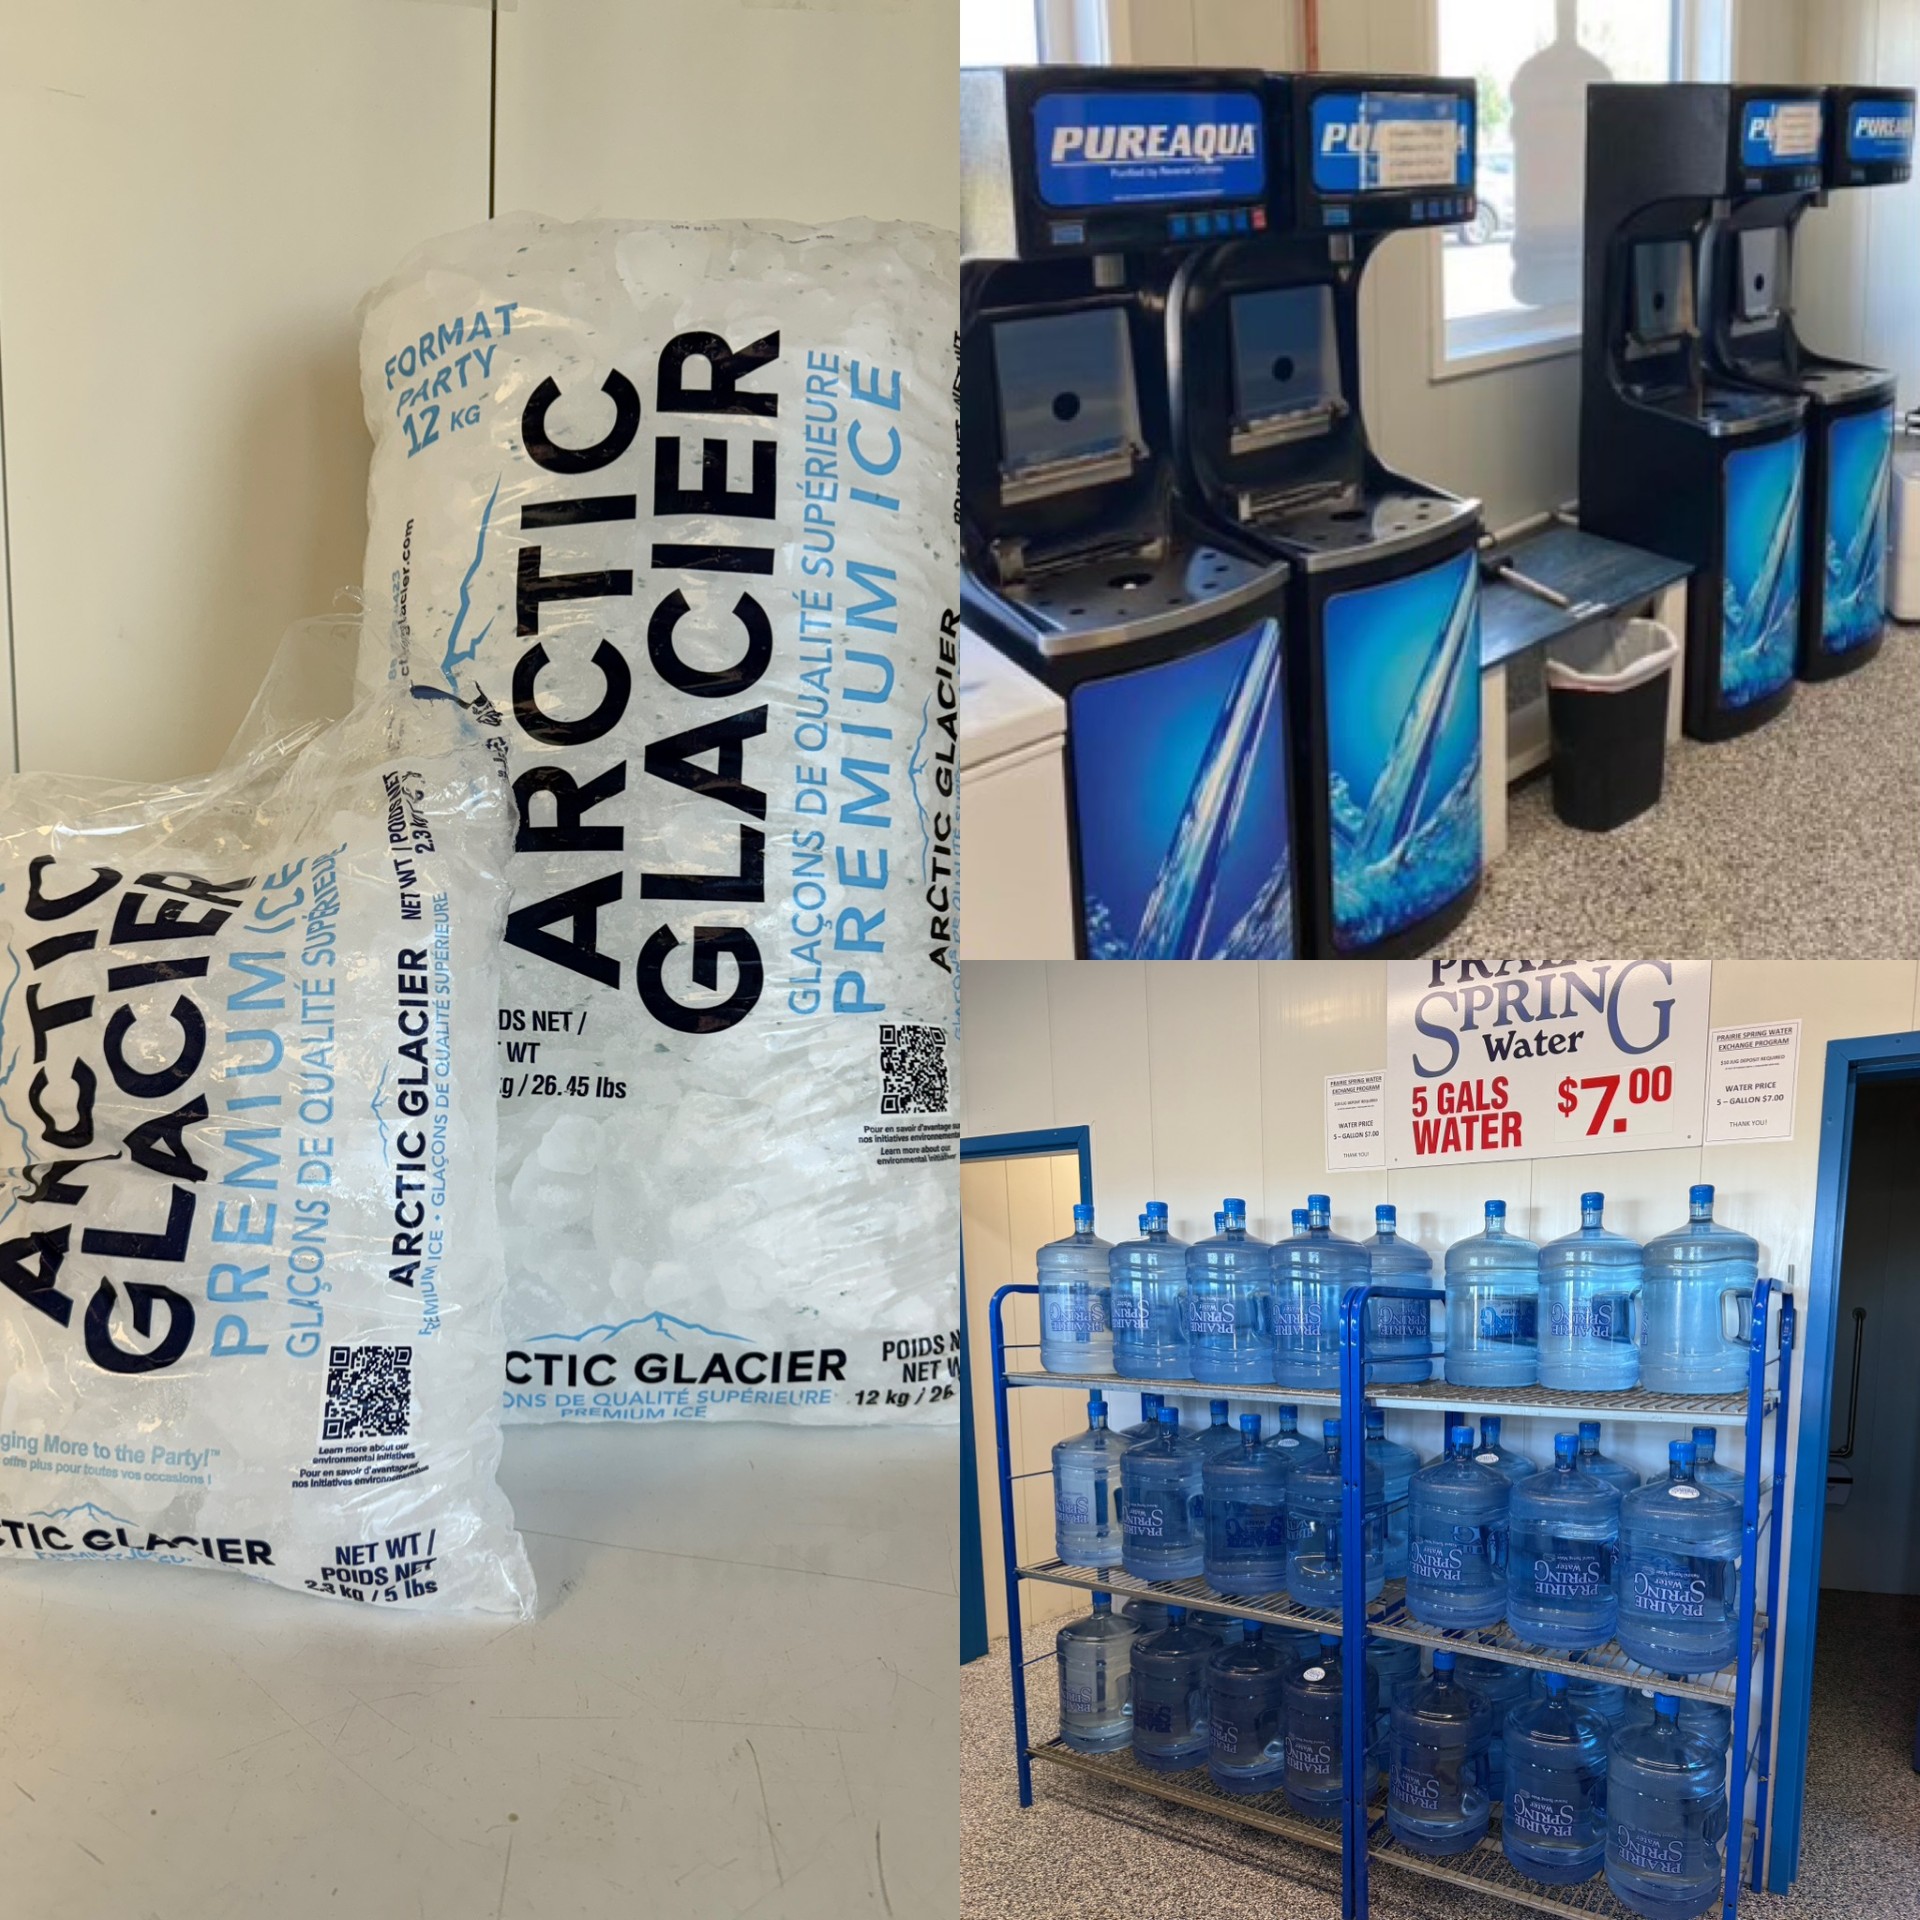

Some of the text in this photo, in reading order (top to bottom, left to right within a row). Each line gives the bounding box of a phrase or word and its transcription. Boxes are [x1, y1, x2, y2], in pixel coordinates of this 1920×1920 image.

[1051, 123, 1255, 163] PUREAQUA
[384, 302, 518, 391] FORMAT
[396, 344, 497, 418] PARTY
[403, 403, 481, 459] 12 KG
[504, 368, 641, 991] ARCTIC
[636, 330, 781, 1035] GLACIER
[788, 351, 839, 1015] GLAÇONS DE QUALITÉ SUPÉRIEURE
[832, 360, 901, 1014] PREMIUM ICE
[935, 608, 960, 797] GLACIER
[387, 798, 408, 843] POIDS
[411, 830, 435, 854] 2.3
[393, 858, 418, 890] WT
[926, 811, 952, 974] ARCTIC
[400, 893, 421, 920] NET
[532, 1010, 573, 1032] NET
[577, 1011, 587, 1035] /
[1412, 960, 1675, 1078] SPRING
[1482, 1030, 1584, 1062] Water
[1717, 1027, 1793, 1042] PRAIRIE SPRING WATER
[1719, 1038, 1789, 1052] EXCHANGE PROGRAM
[294, 978, 335, 1125] QUALITÉ
[506, 1041, 541, 1063] WT
[531, 1074, 627, 1099] 26.45 lbs
[1348, 1077, 1364, 1085] SPRING
[1366, 1075, 1382, 1083] WATER
[1725, 1081, 1776, 1092] WATER PRICE
[1412, 1076, 1509, 1117] 5 GALS
[1557, 1065, 1672, 1136] $7.00
[1729, 1093, 1784, 1105] GALLON $7.00
[82, 868, 257, 1374] GLACIER
[388, 948, 429, 1288] ARCTIC GLACIER
[418, 892, 451, 1336] PREMIUM ICE GLAÇONS DE QUALITÉ SUPÉRIEURE
[1729, 1120, 1750, 1128] THANK
[863, 1125, 883, 1134] Pour
[896, 1124, 916, 1133] savoir
[874, 1134, 909, 1143] initiatives
[1342, 1132, 1364, 1140] GALLON
[1412, 1111, 1522, 1155] WATER
[206, 951, 286, 1357] PREMIUM
[296, 1137, 334, 1185] DE
[877, 1154, 928, 1165] environmental
[881, 1147, 901, 1156] Learn
[902, 1147, 920, 1155] more
[921, 1145, 939, 1153] about
[285, 1199, 332, 1358] GLAÇONS
[882, 1334, 945, 1362] POIDS
[634, 1348, 847, 1385] GLACIER
[902, 1360, 941, 1383] NET
[555, 1393, 584, 1407] DE
[592, 1388, 689, 1409] QUALITÉ
[696, 1387, 832, 1405] SUPÉRIEURE
[855, 1390, 880, 1406] 12
[885, 1389, 910, 1407] kg
[561, 1405, 707, 1420] PREMIUM ICE
[44, 1434, 89, 1457] More
[93, 1441, 111, 1460] to
[115, 1444, 145, 1463] the
[312, 1451, 416, 1464] environmental initiatives
[318, 1442, 409, 1455] Learn more about our
[30, 1458, 53, 1471] plus
[56, 1463, 81, 1475] pour
[83, 1464, 118, 1478] toutes
[121, 1469, 141, 1481] vos
[143, 1471, 204, 1485] occasions
[292, 1480, 309, 1488] nos
[310, 1478, 352, 1487] initiatives
[300, 1468, 321, 1478] Pour
[322, 1468, 334, 1477] en
[336, 1467, 362, 1476] savoir
[335, 1528, 436, 1566] NET WT /
[1411, 1541, 1463, 1569] SPRING
[321, 1566, 389, 1586] POIDS
[1411, 1561, 1461, 1581] PRAIRIE
[1534, 1560, 1600, 1584] SPRING
[1556, 1564, 1581, 1572] Water
[304, 1580, 336, 1595] 2.3
[384, 1585, 398, 1602] 5
[404, 1579, 438, 1599] lbs
[1535, 1582, 1599, 1597] PRAIRIE
[1634, 1572, 1706, 1603] SPRING
[1654, 1579, 1682, 1590] Water
[1634, 1594, 1704, 1617] PRAIRIE
[1514, 1794, 1574, 1826] SPRING
[1514, 1814, 1573, 1837] PRAIRIE
[1618, 1825, 1684, 1862] SPRING
[1618, 1846, 1681, 1874] PRAIRIE
